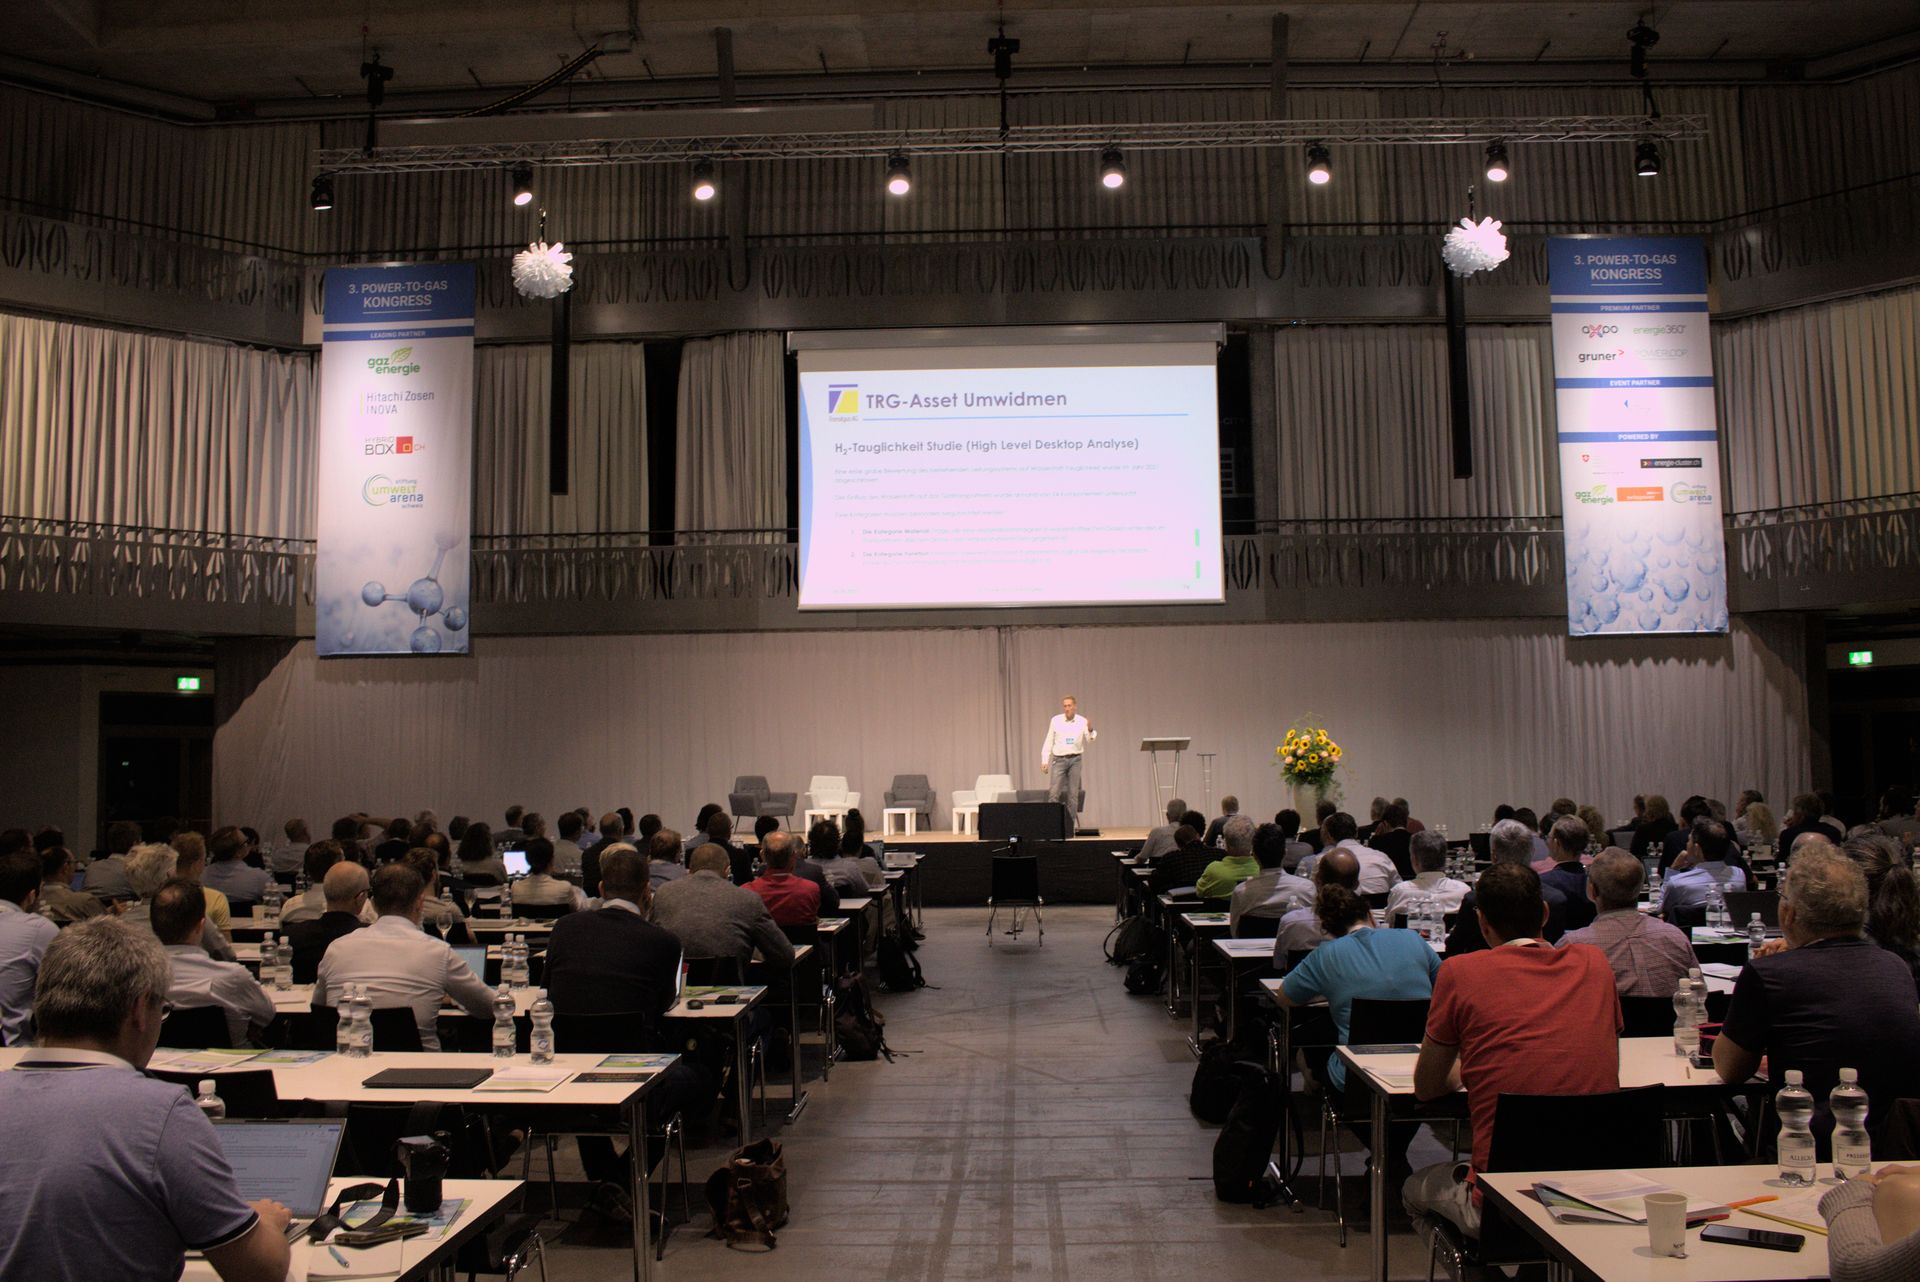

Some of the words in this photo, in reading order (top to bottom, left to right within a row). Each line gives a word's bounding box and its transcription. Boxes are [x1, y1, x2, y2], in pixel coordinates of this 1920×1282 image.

[1574, 255, 1585, 265] 3.
[1587, 254, 1677, 265] POWER-TO-GAS
[1590, 268, 1662, 280] KONGRESS
[348, 284, 359, 294] 3.
[361, 280, 448, 294] POWER-TO-GAS
[363, 294, 432, 308] KONGRESS
[370, 331, 396, 339] LEADING
[367, 357, 390, 368] gaz
[1578, 352, 1616, 363] gruner
[375, 362, 420, 376] energie
[367, 391, 403, 402] Hitachi
[405, 390, 434, 401] Zosen
[866, 393, 957, 409] TRG-Asset
[964, 391, 1067, 408] Umwidmen
[366, 404, 398, 415] INOVA
[365, 443, 395, 456] BOX
[927, 440, 962, 451] Studie
[966, 440, 997, 453] (High
[1001, 439, 1032, 450] Level
[1035, 438, 1083, 451] Desktop
[1087, 438, 1139, 451] Analyse)
[372, 485, 417, 495] umwelt
[1575, 491, 1592, 499] gaz
[390, 493, 424, 503] arena
[1581, 494, 1614, 505] energie
[1689, 494, 1713, 502] arena
